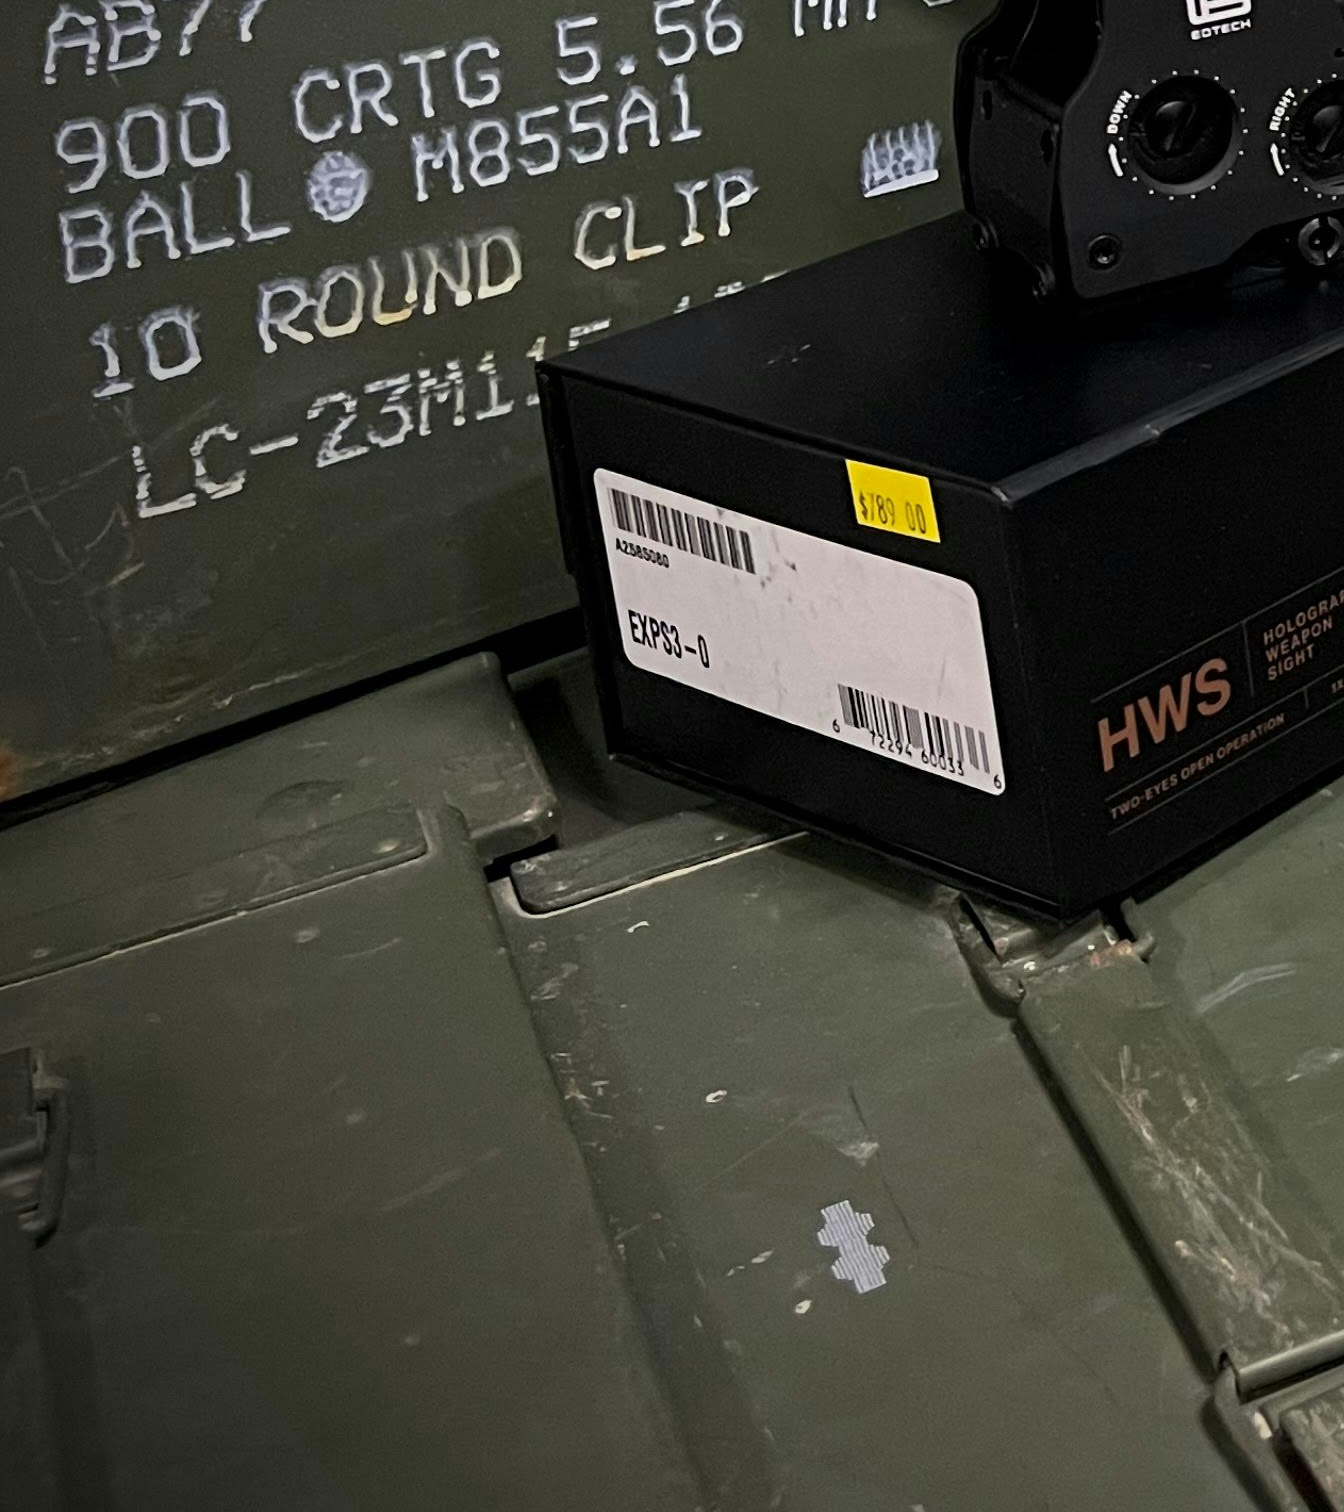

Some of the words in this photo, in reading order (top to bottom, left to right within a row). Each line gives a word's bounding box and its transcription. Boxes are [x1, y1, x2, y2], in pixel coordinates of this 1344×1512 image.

[1190, 18, 1252, 41] EOTECH
[55, 93, 231, 194] 900
[292, 36, 501, 144] CRTG
[1106, 89, 1133, 135] DOWN
[1269, 87, 1296, 132] RIGHT
[59, 171, 290, 284] BALL
[411, 74, 702, 203] M855A1
[90, 306, 201, 399] 10
[256, 230, 523, 355] ROUND
[574, 168, 759, 271] CLIP
[627, 608, 711, 670] EXPS3-0
[1264, 615, 1334, 664] WEAPON
[1266, 643, 1315, 682] SIGHT
[1098, 656, 1233, 774] HWS
[1109, 773, 1179, 821] TWO-EYES
[1180, 752, 1216, 781] OPEN
[1215, 711, 1287, 761] OPERATION
